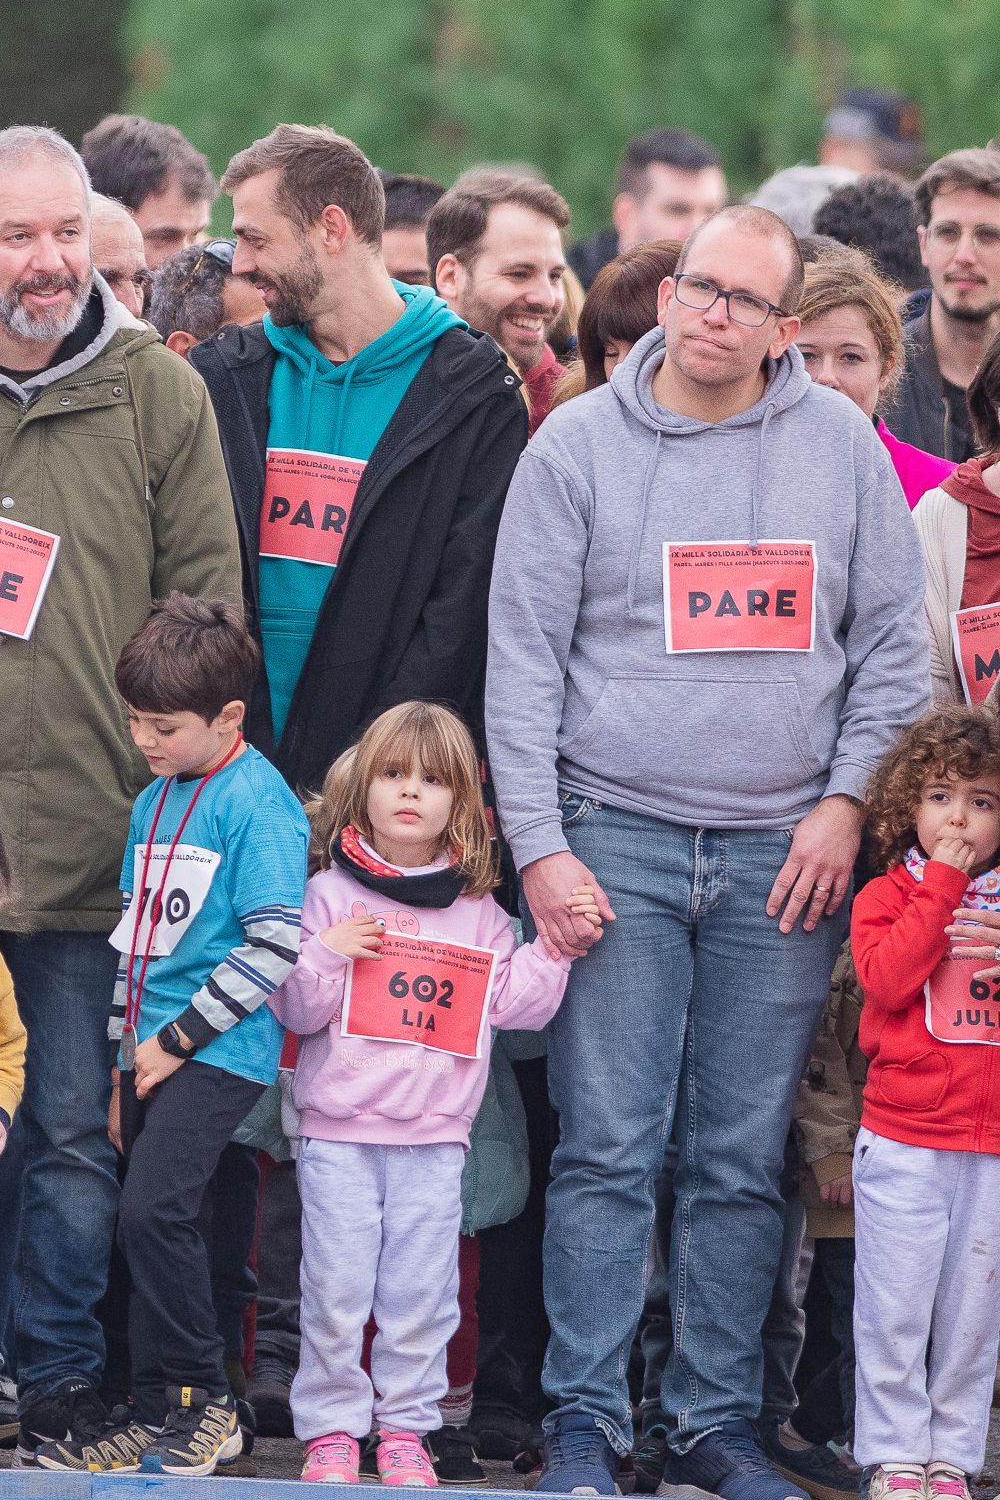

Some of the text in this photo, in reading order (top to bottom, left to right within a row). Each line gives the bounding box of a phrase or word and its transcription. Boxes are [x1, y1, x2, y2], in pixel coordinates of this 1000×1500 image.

[338, 466, 349, 474] DE
[5, 529, 50, 549] VALLDOREIX
[688, 589, 796, 618] PARE
[969, 615, 991, 624] MILLA
[395, 941, 434, 954] SOLIDÀRIA
[448, 950, 490, 965] VALLDOREIX
[388, 971, 454, 1009] 602
[402, 1009, 436, 1031] LIA
